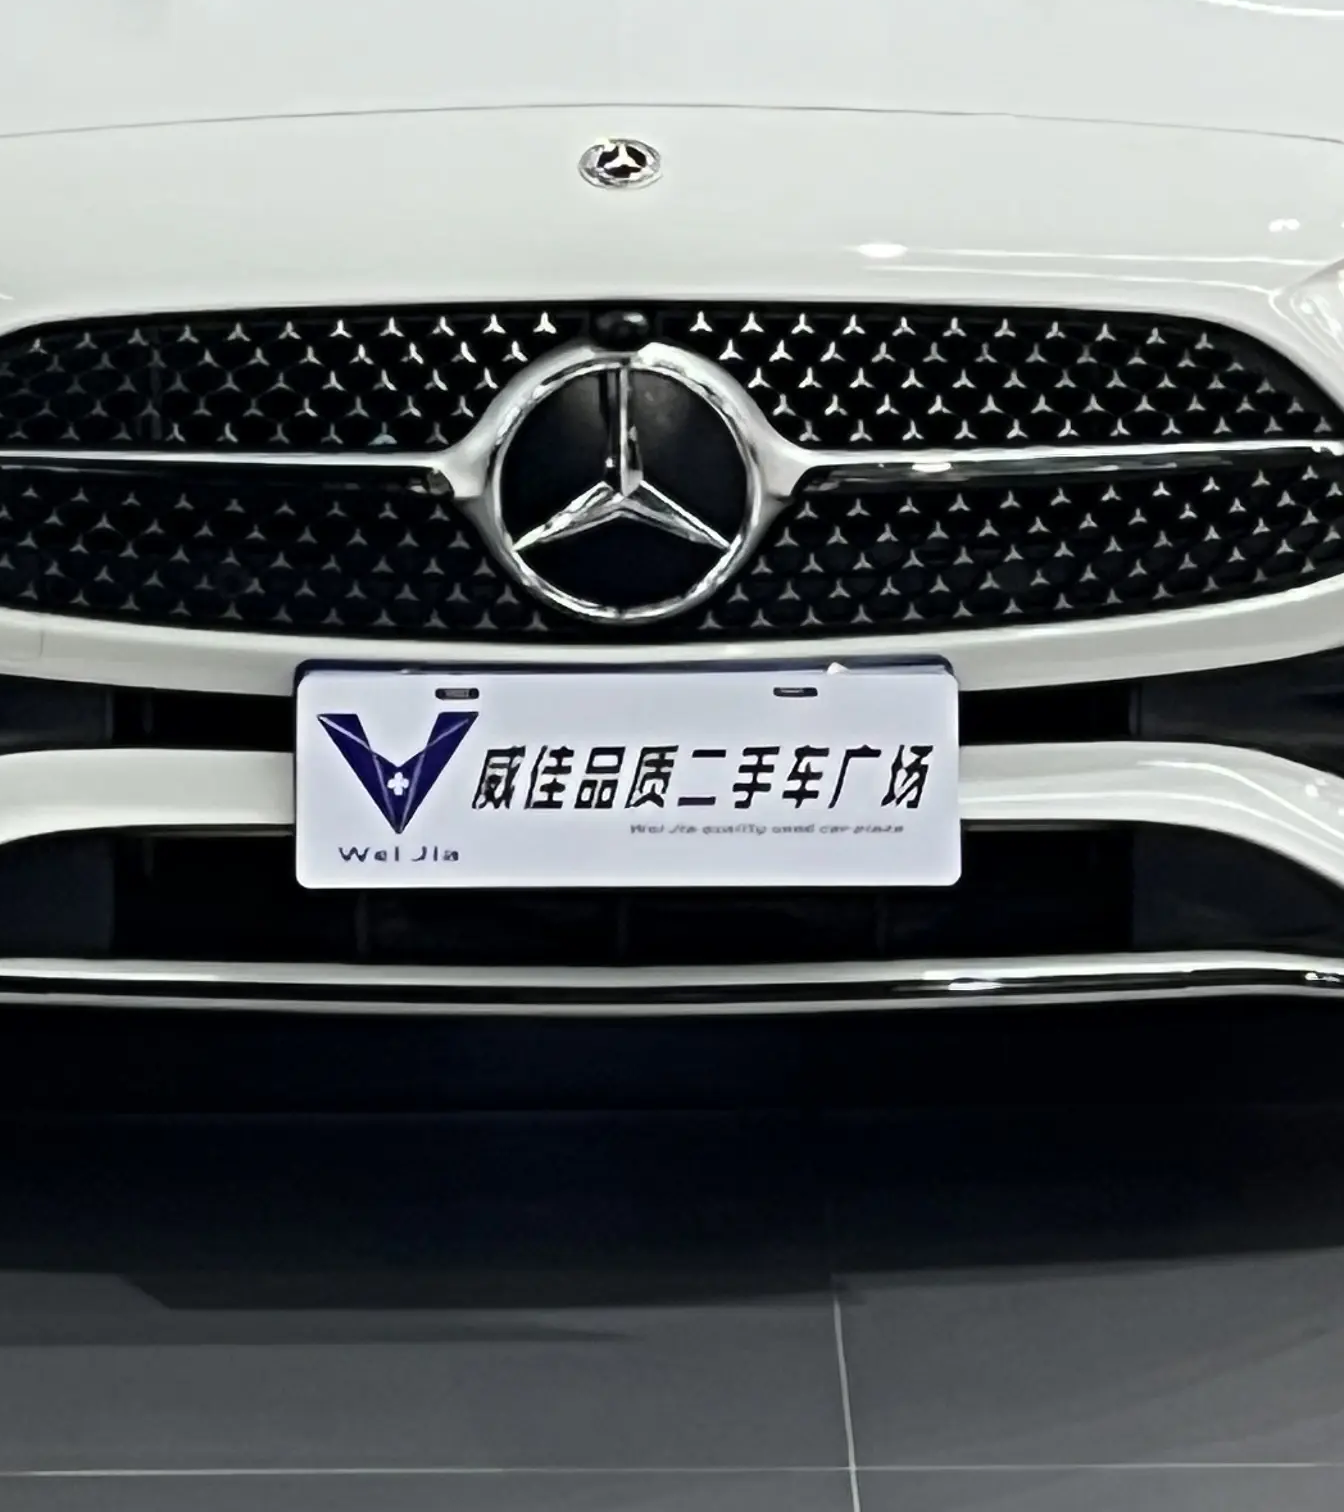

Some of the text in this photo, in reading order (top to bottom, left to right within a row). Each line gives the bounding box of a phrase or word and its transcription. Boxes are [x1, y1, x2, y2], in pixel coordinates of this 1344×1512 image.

[471, 744, 934, 810] 威佳品质二手车广场
